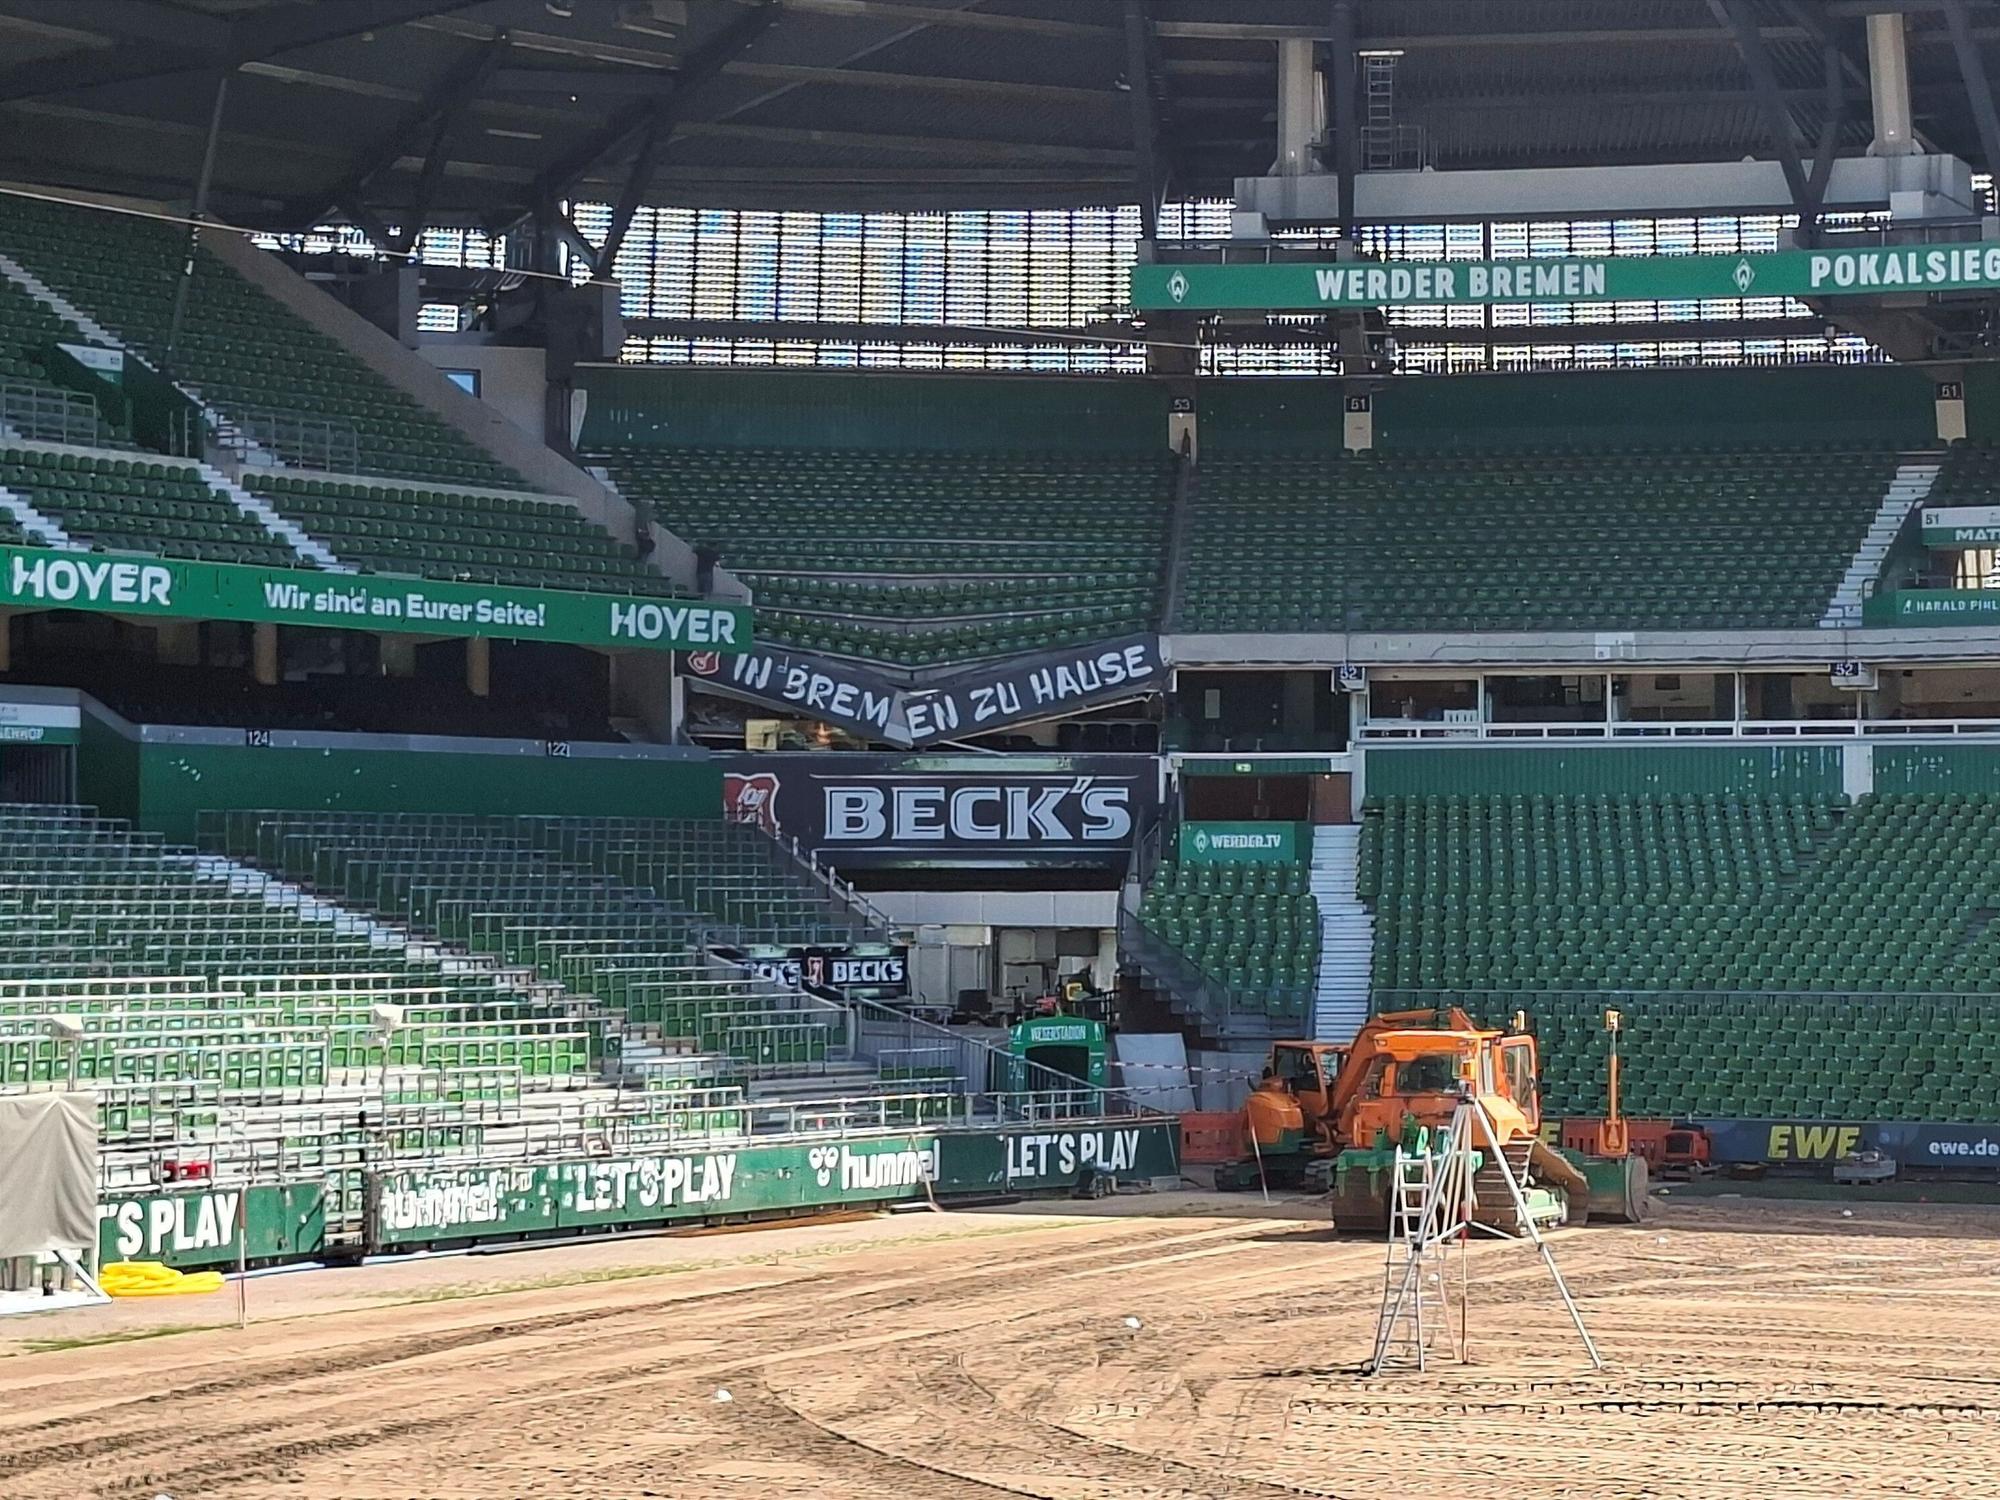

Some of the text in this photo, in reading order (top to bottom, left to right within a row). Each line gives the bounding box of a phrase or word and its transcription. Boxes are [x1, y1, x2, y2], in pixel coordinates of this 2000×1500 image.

[1315, 263, 1606, 302] WERDER BREMEN
[1811, 248, 2000, 288] POKALSIEG
[11, 556, 172, 607] HOYER
[264, 582, 545, 628] Wir sind an Eurer Seite!
[610, 602, 737, 644] HOYER
[733, 653, 773, 690] IN
[969, 682, 1022, 722] ZU
[1029, 645, 1154, 705] HAUSE
[248, 730, 269, 746] 124
[822, 775, 1132, 841] BECK'S
[841, 1139, 940, 1191] hummel
[1007, 1129, 1140, 1178] LET'S PLAY
[1767, 1125, 1861, 1160] EWE
[1928, 1138, 2000, 1156] ewe.de
[662, 1154, 737, 1206] PLAY
[150, 1192, 239, 1254] PLAY
